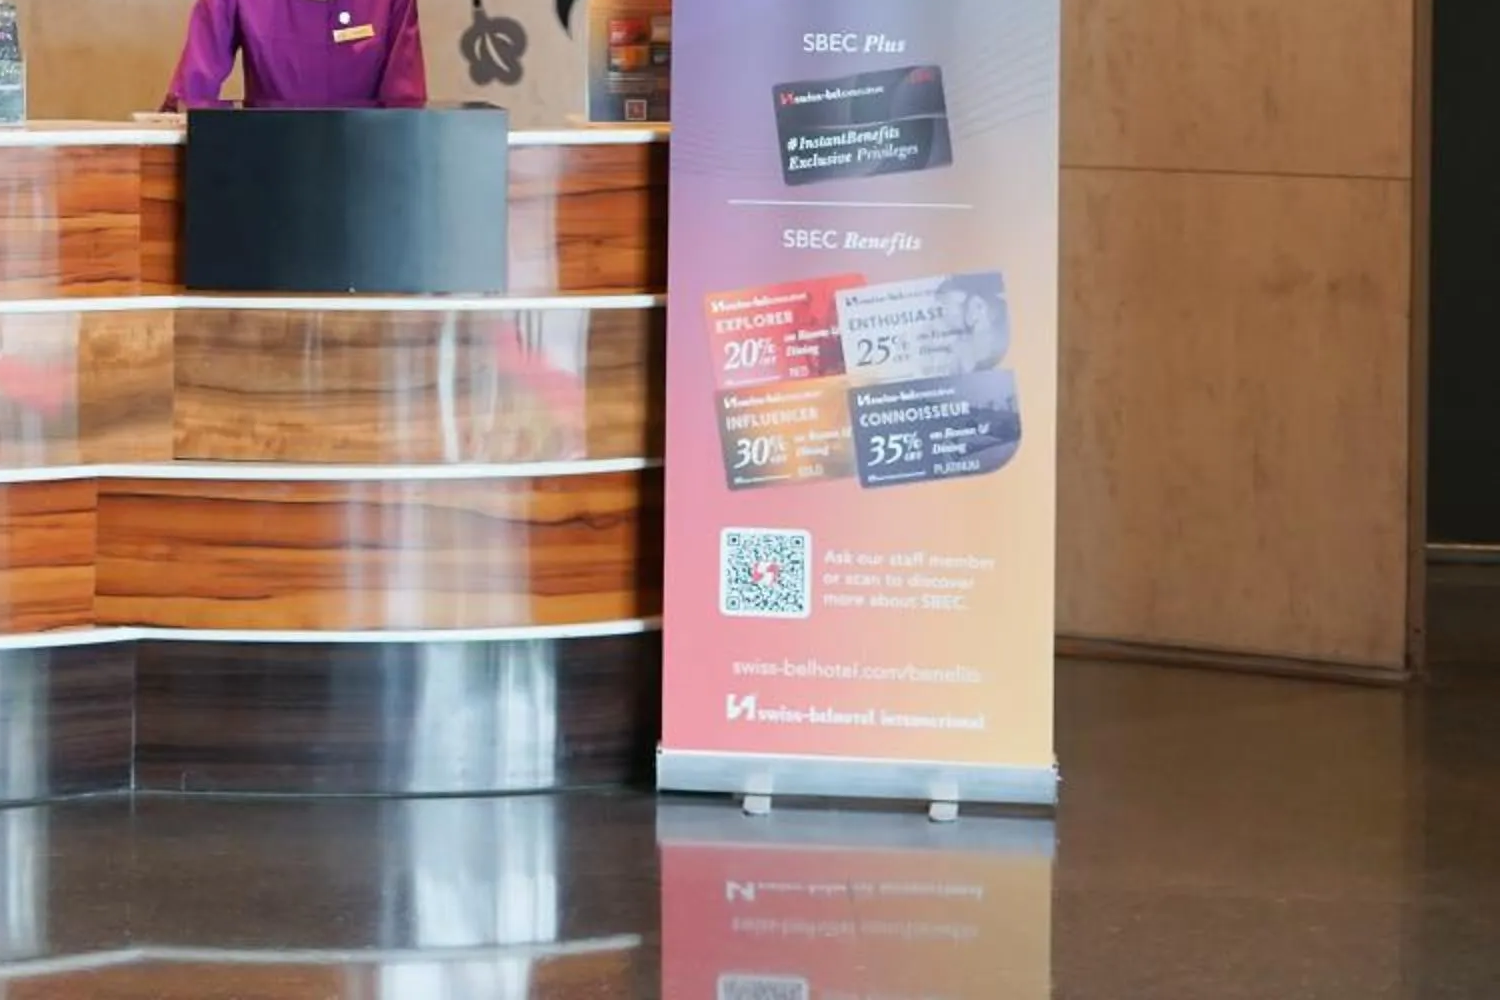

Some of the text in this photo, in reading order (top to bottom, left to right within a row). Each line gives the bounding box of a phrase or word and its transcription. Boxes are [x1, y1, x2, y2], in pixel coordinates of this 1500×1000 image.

[803, 33, 906, 54] SBEC Plus
[787, 126, 900, 151] #InstantBenefits
[788, 143, 919, 171] Exclusive Privileges
[783, 230, 922, 256] SBEC Benefits
[716, 311, 793, 333] EXPLORER
[848, 306, 944, 331] ENTHUSIAST
[726, 407, 818, 431] INFLUENCER
[859, 401, 970, 427] CONNOISSEUR
[824, 550, 995, 569] Ask our staff member
[823, 574, 840, 585] or
[845, 574, 880, 586] scan
[885, 573, 903, 586] to
[823, 595, 864, 608] more
[869, 594, 917, 608] about
